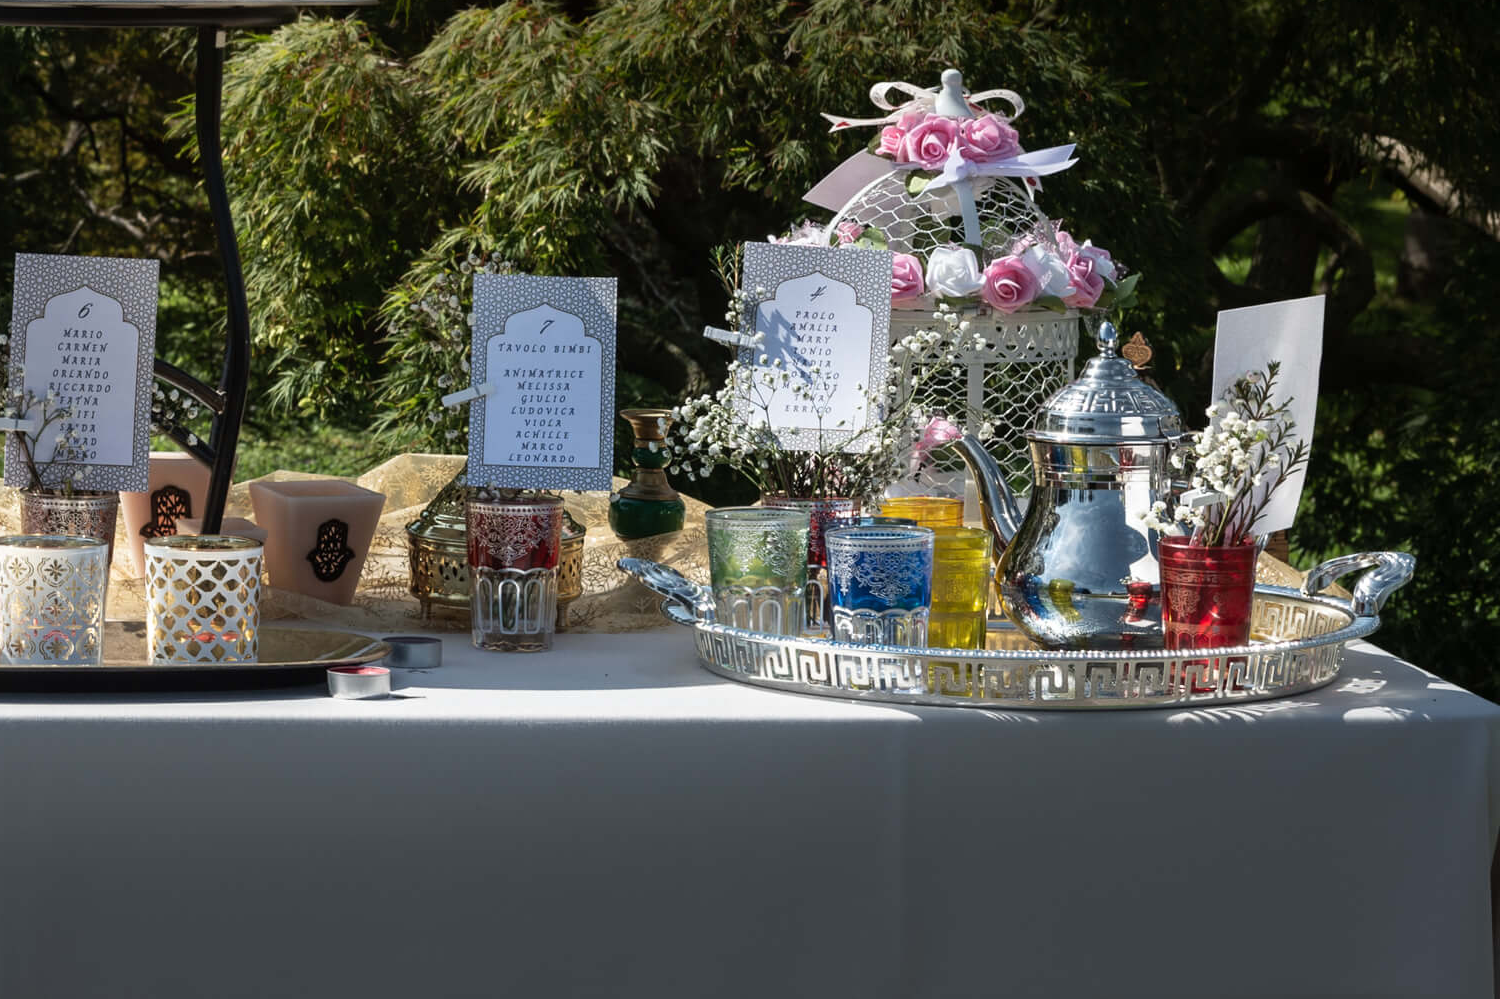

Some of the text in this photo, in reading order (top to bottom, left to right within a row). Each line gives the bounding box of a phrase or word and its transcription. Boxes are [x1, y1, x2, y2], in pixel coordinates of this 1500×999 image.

[78, 303, 93, 319] 6
[796, 310, 835, 320] PAOLO
[540, 320, 555, 334] 7
[790, 322, 838, 332] AMALIA
[64, 328, 102, 339] MARIO
[796, 334, 830, 344] MARY
[58, 342, 108, 352] CARMEN
[498, 342, 592, 354] TAVOLO BIMBI
[62, 355, 100, 366] MARIA
[52, 368, 109, 380] ORLANDO
[504, 368, 584, 378] ANIMATRICE
[50, 382, 111, 394] RICCARDO
[518, 381, 570, 391] MELISSA
[521, 394, 566, 405] GIULIO
[795, 394, 824, 402] TNA
[511, 406, 575, 416] LUDOVICA
[524, 419, 562, 427] VIOLA
[516, 430, 570, 440] ACHILLE
[522, 441, 563, 451] MARCO
[508, 453, 575, 463] LEONARDO
